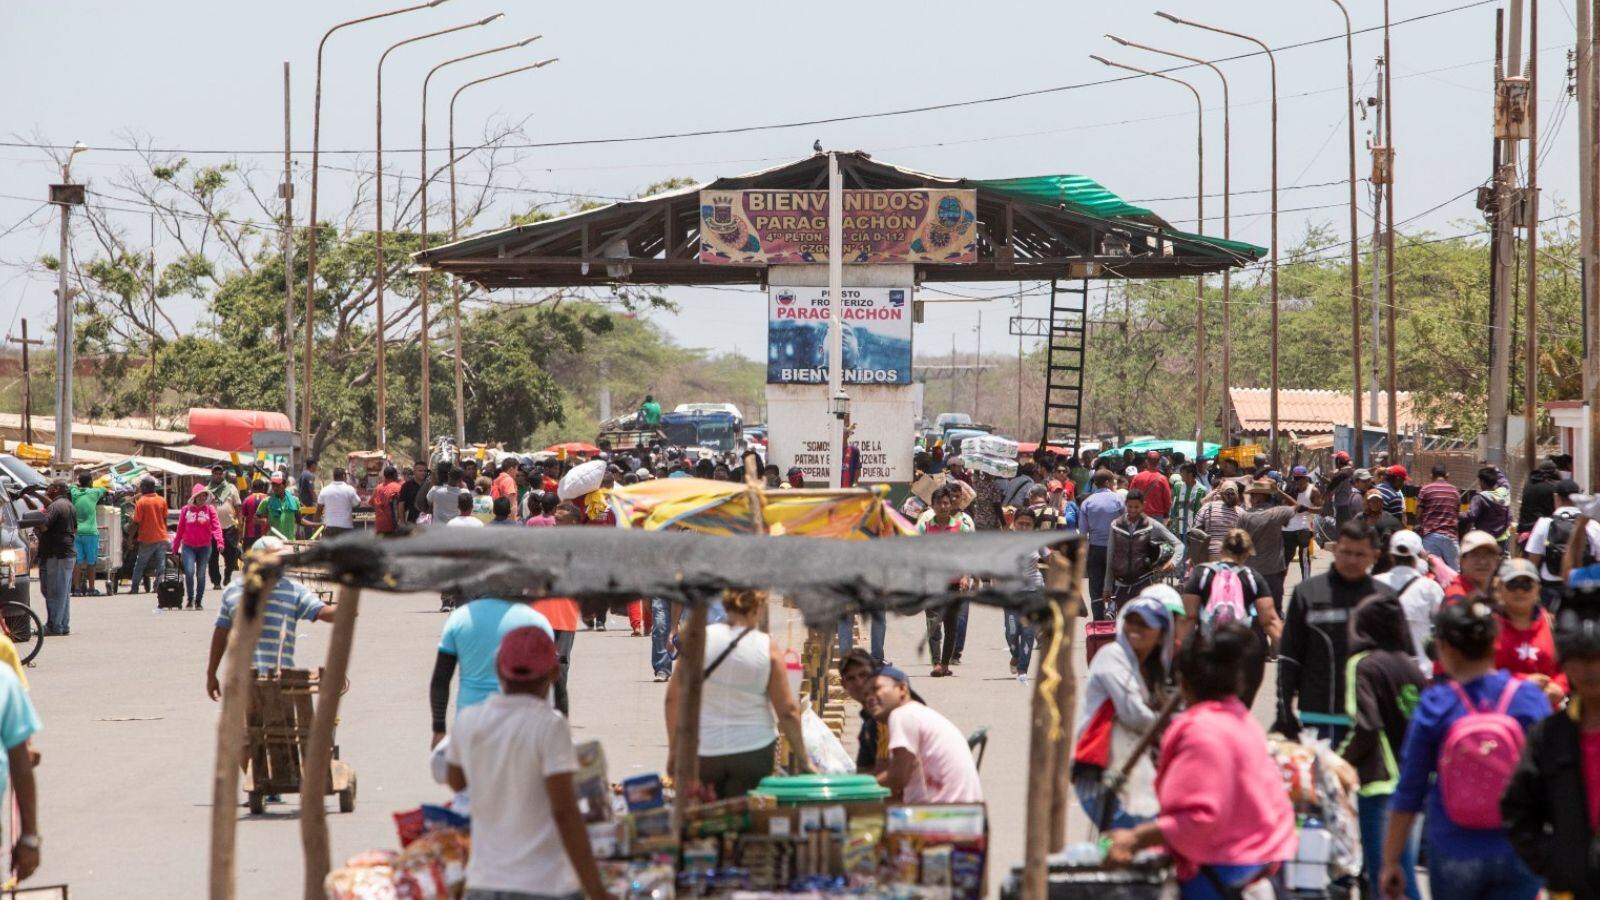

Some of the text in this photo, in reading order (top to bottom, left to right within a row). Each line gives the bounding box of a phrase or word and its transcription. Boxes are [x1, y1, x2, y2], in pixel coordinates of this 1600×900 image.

[749, 192, 924, 211] BIENVNIDOS
[756, 213, 917, 229] PARAGACHÓN
[785, 233, 822, 241] PLTON
[873, 233, 905, 241] D-112
[821, 290, 860, 298] PSTO
[777, 306, 902, 320] PARAGACHÓN
[781, 368, 898, 381] BIENVNIDOS
[862, 440, 871, 451] DE
[872, 440, 882, 451] LA
[795, 454, 819, 465] PATRIA
